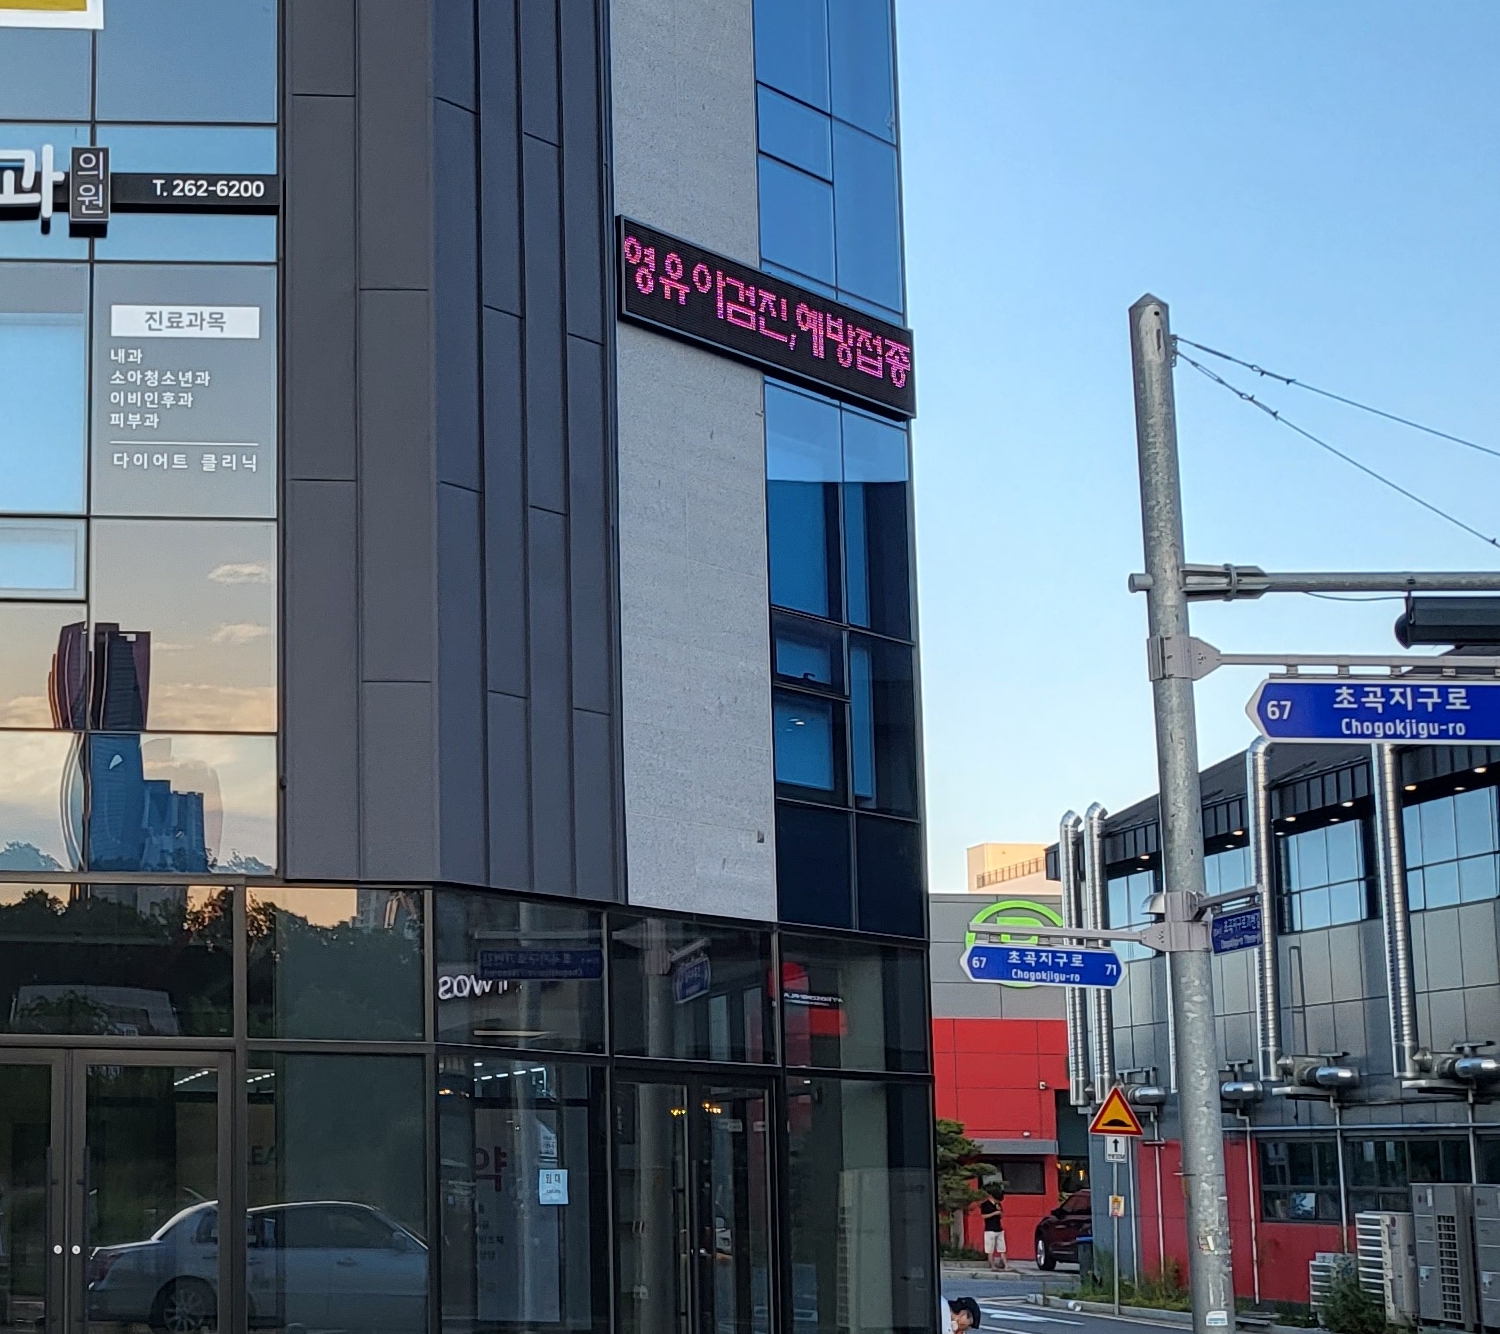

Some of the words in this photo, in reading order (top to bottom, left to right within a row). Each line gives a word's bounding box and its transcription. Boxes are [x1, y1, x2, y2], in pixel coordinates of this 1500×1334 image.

[77, 151, 104, 214] 의원
[172, 180, 265, 198] 262-6200
[144, 310, 227, 333] 진료과목
[110, 348, 143, 365] 내과
[109, 370, 211, 387] 소아청소년과
[109, 391, 194, 409] 이비인후과
[109, 412, 160, 430] 피부과
[113, 452, 189, 470] 다이어트
[201, 453, 258, 473] 클리닉
[1266, 700, 1292, 720] 67
[1333, 686, 1471, 714] 초곡지구로
[1341, 718, 1467, 739] Chogokjigu-ro
[971, 956, 987, 969] 67
[1006, 950, 1085, 968] 초곡지구로
[1104, 963, 1117, 976] 71
[1011, 968, 1080, 983] Chogokjigu-ro
